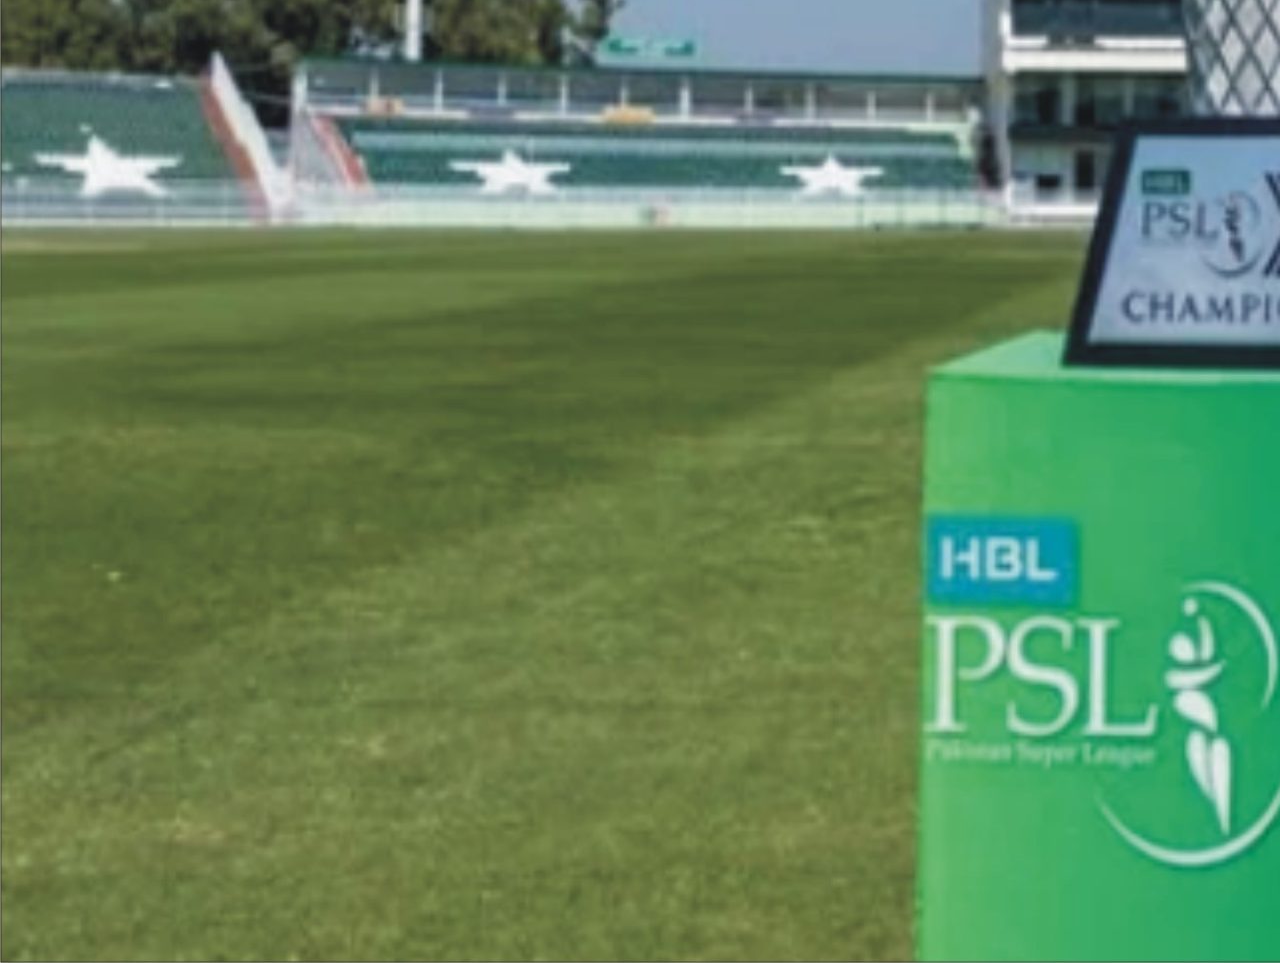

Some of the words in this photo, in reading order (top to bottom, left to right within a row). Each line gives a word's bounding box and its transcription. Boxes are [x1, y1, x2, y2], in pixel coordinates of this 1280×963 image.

[1141, 202, 1219, 239] PSL
[940, 537, 1057, 581] HBL
[924, 615, 1158, 737] PSL
